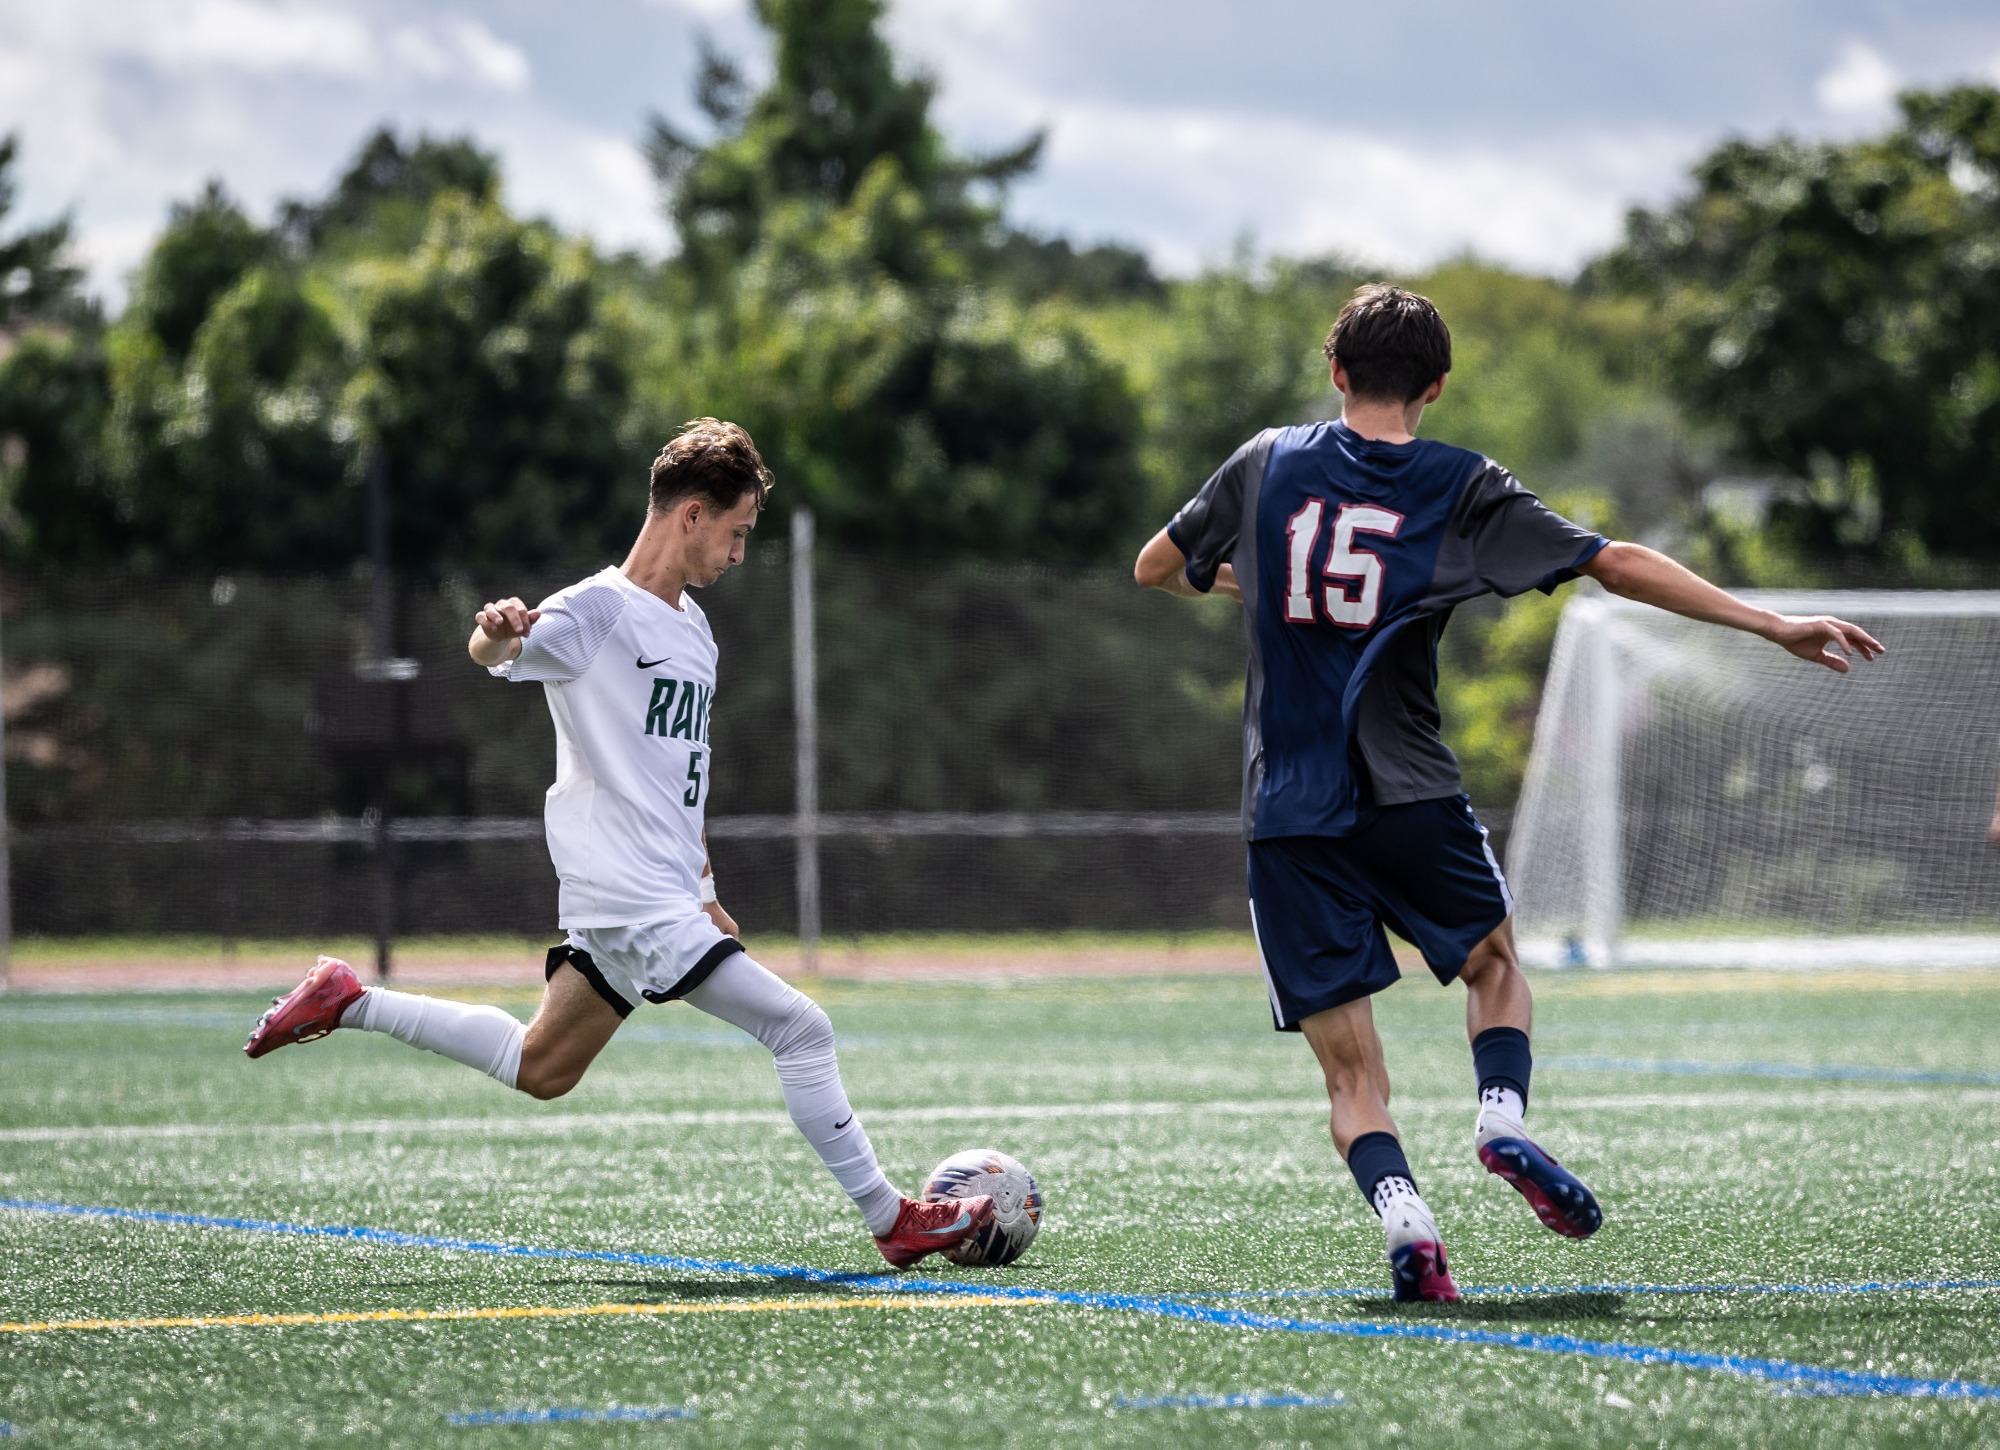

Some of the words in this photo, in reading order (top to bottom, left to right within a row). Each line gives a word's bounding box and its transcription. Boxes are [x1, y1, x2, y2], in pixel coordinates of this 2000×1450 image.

[1284, 497, 1405, 630] 15
[645, 678, 712, 744] RAM
[683, 751, 702, 807] 5
